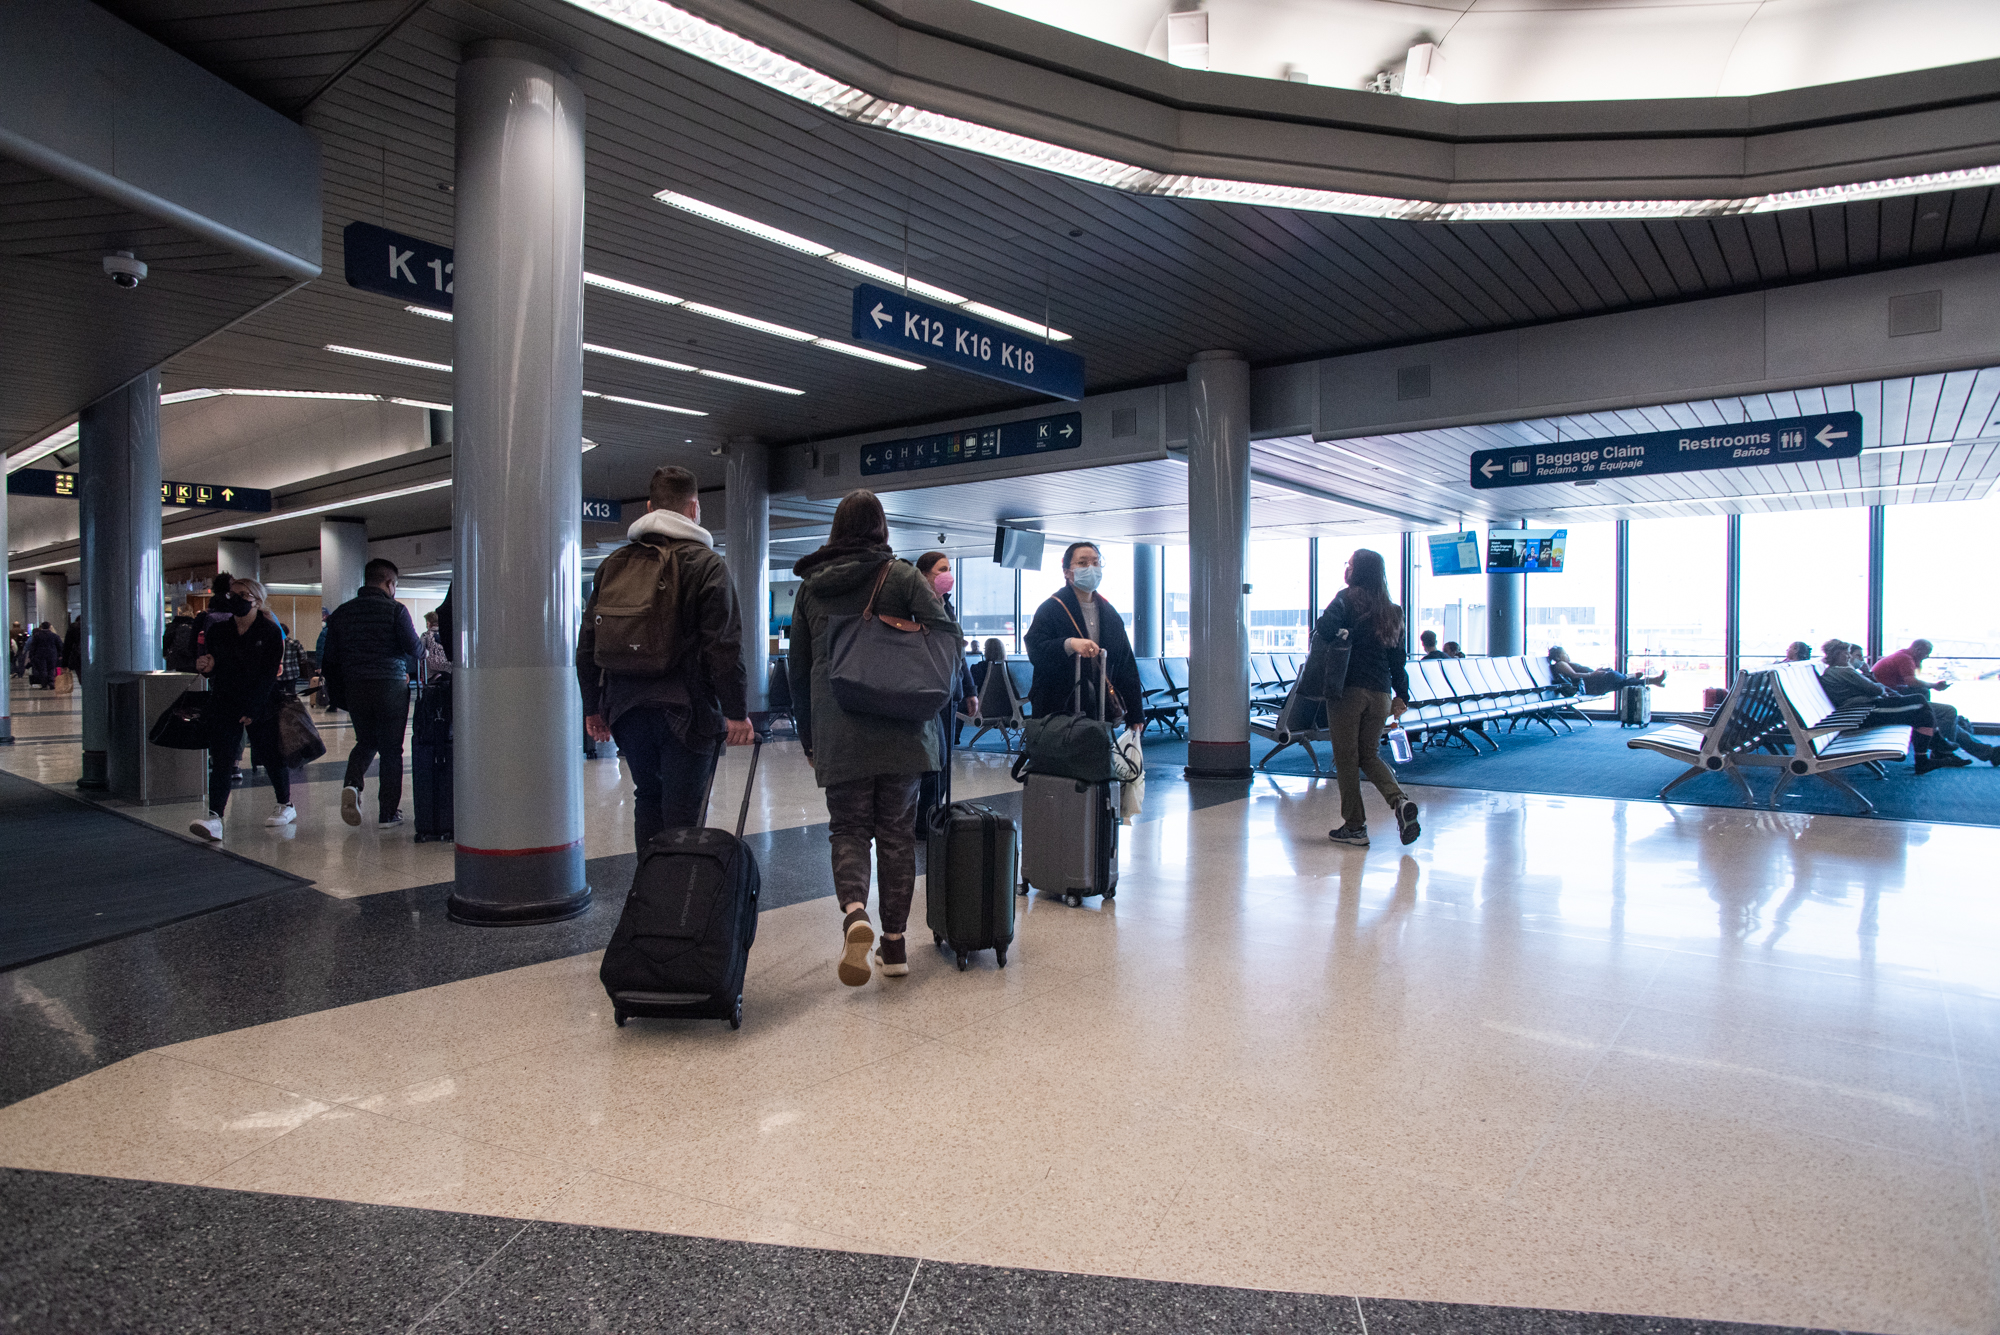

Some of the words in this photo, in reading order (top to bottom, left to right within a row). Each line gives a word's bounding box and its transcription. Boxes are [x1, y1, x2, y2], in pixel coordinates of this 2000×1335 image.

[389, 245, 417, 285] K
[905, 311, 944, 347] K12
[955, 328, 991, 361] K16
[1001, 343, 1035, 374] K18
[1039, 425, 1048, 437] K
[885, 449, 893, 460] G
[901, 447, 908, 458] H
[916, 444, 924, 456] K
[933, 442, 940, 453] L
[1678, 433, 1771, 451] Restrooms
[1535, 450, 1599, 466] Baggage
[1602, 445, 1645, 459] Claim
[1732, 446, 1770, 458] Baños
[1536, 466, 1578, 476] Reclamo
[1582, 463, 1595, 472] de
[1599, 459, 1644, 471] Equipaje
[178, 486, 189, 496] K
[199, 487, 209, 498] L
[582, 501, 611, 518] K13
[688, 864, 697, 890] UNDER
[680, 891, 691, 926] ARMOUR
